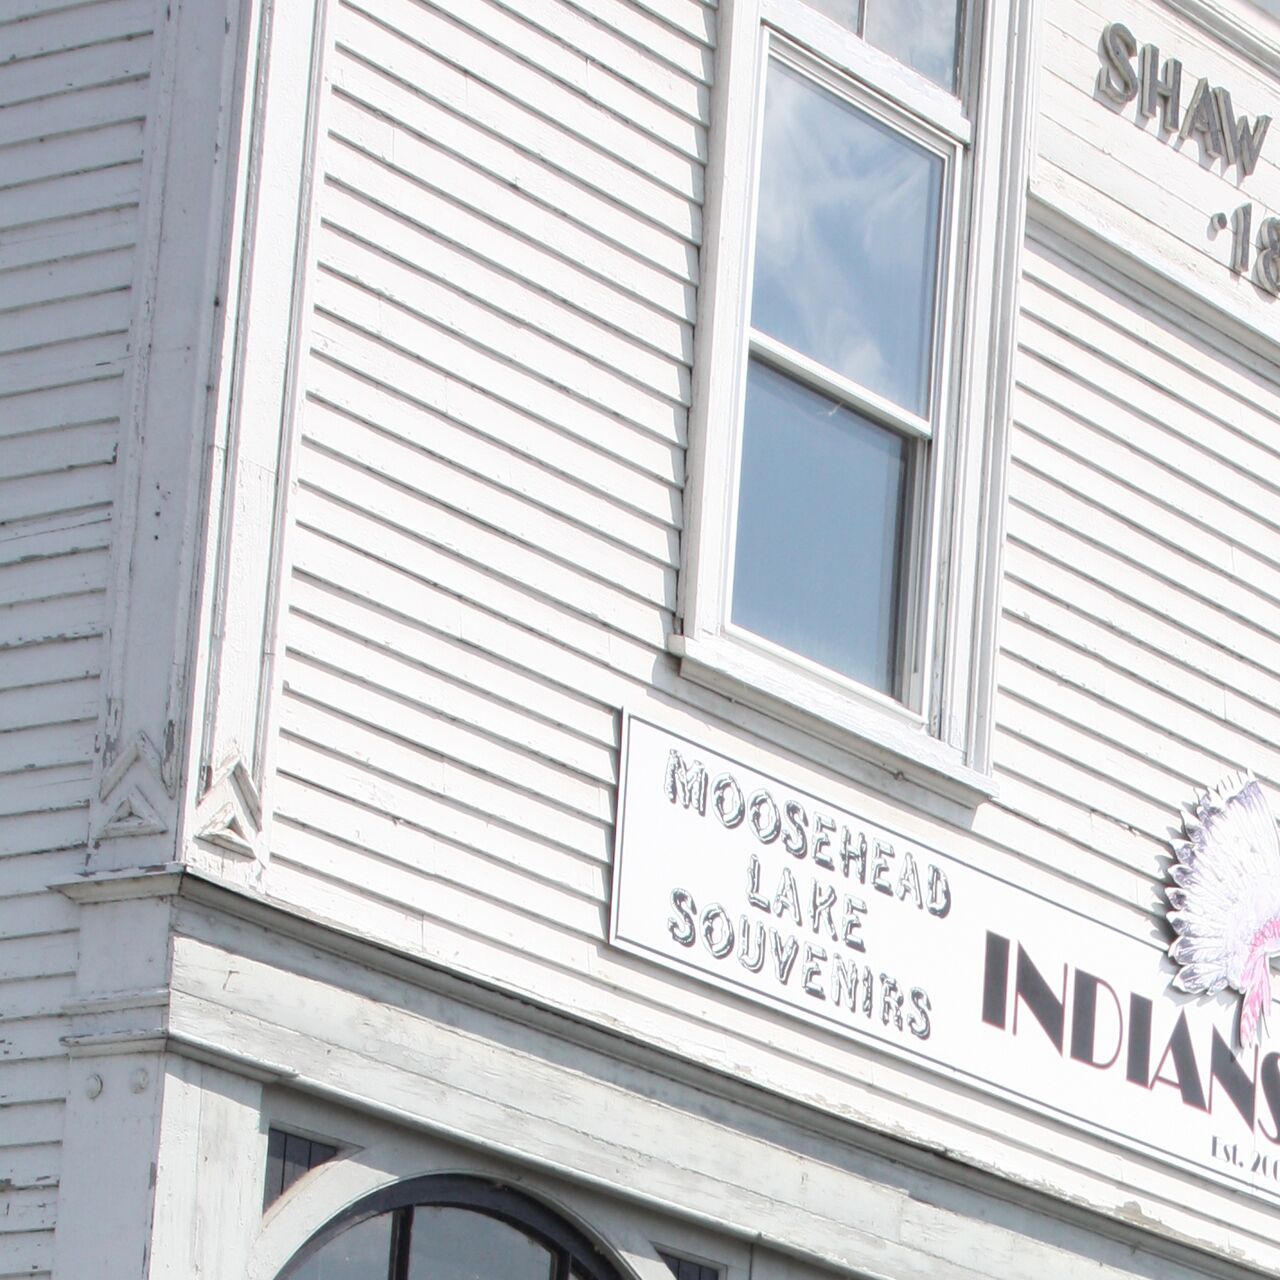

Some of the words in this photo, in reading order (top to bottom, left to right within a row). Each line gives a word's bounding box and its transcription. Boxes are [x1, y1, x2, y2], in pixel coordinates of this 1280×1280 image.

[1096, 22, 1272, 176] SHAW
[664, 748, 951, 918] MOOSEHEAD
[746, 854, 867, 951] LAKE
[667, 887, 932, 1039] SOUVENIRS
[1211, 1135, 1243, 1168] Est.
